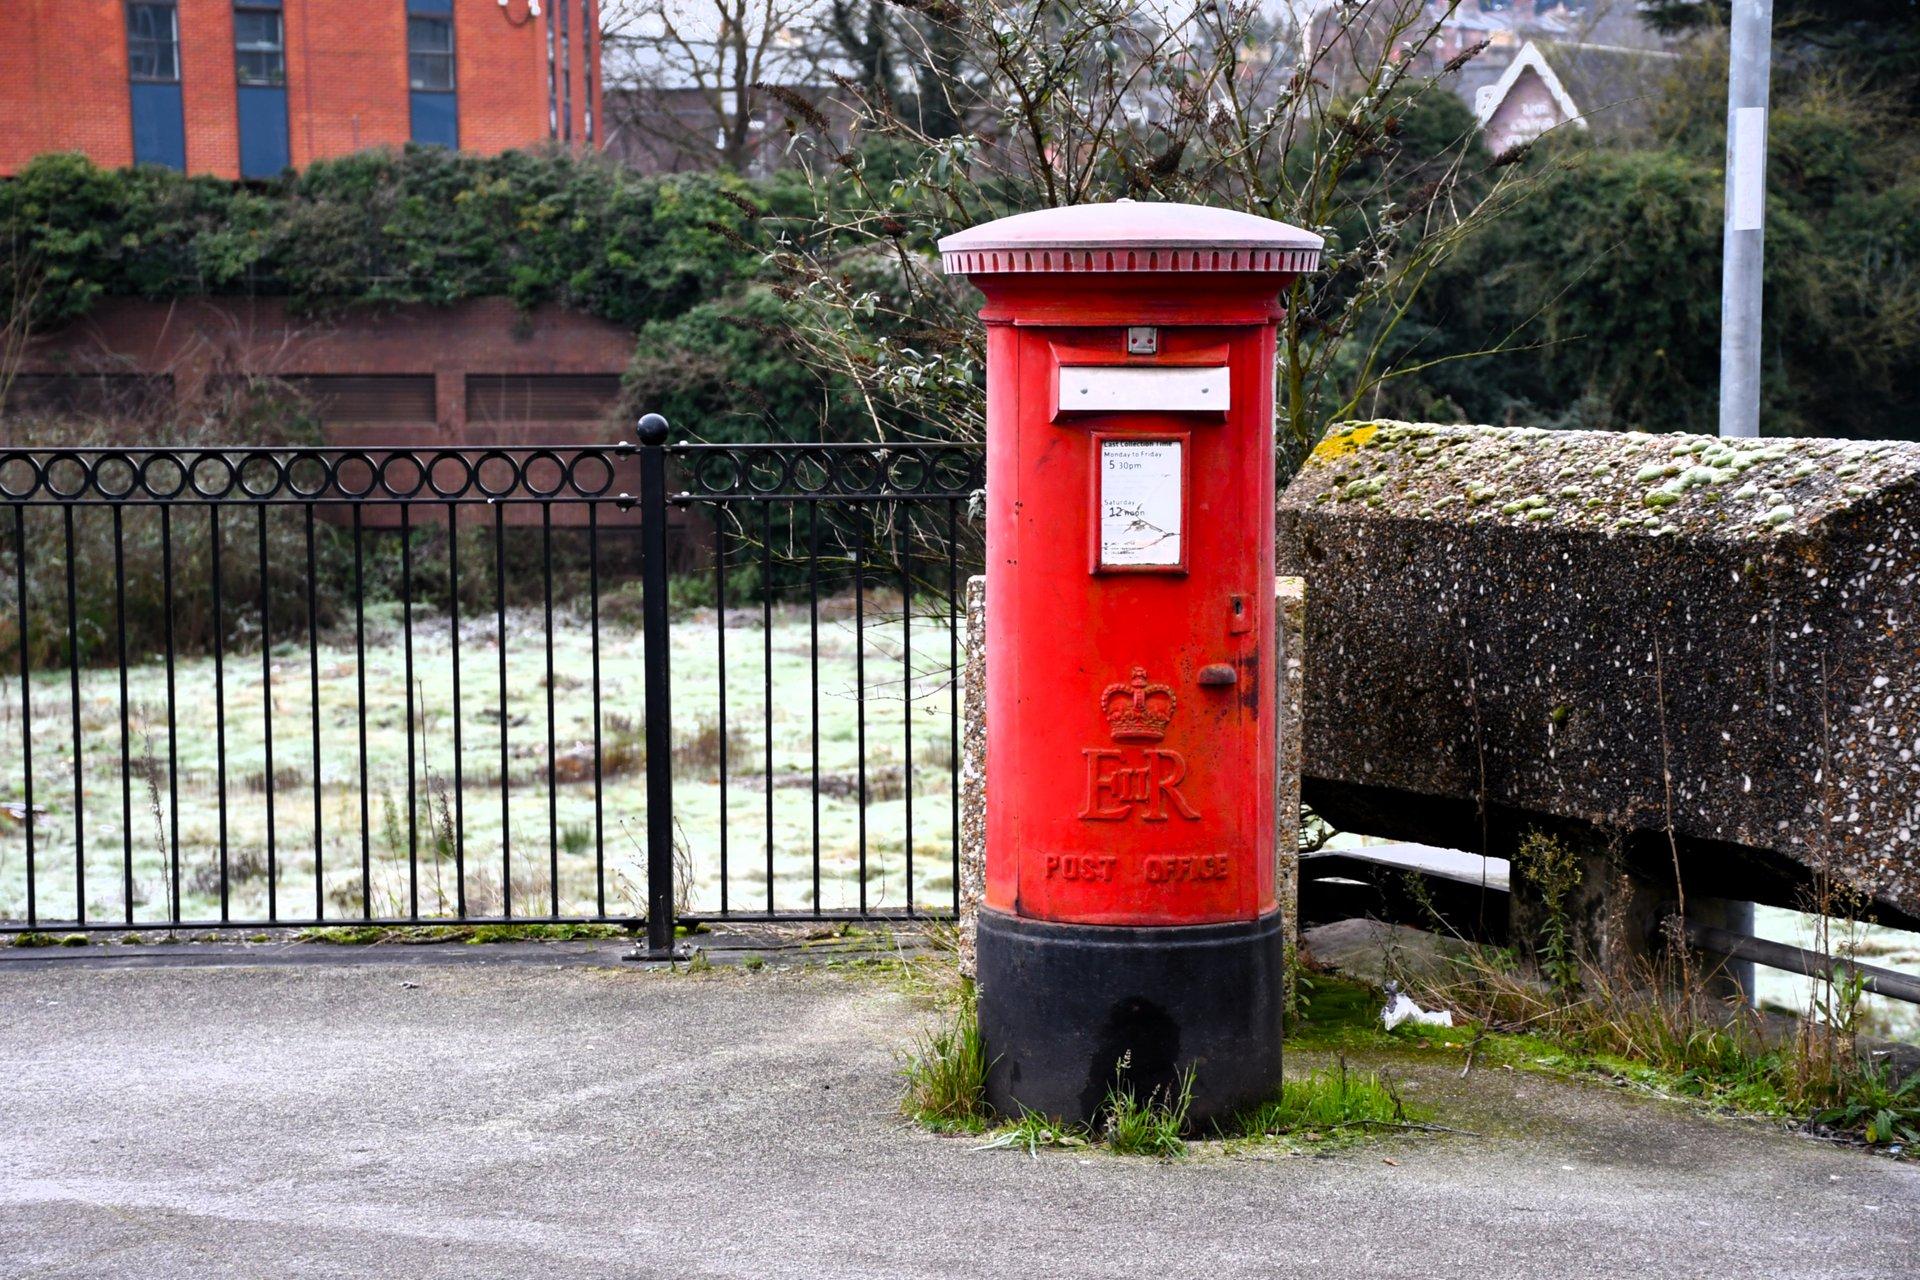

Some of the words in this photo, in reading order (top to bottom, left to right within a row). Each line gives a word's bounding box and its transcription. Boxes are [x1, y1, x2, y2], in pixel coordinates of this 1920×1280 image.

[1109, 506, 1122, 518] 12
[1045, 853, 1117, 882] POST
[1144, 853, 1229, 883] OFFICE
